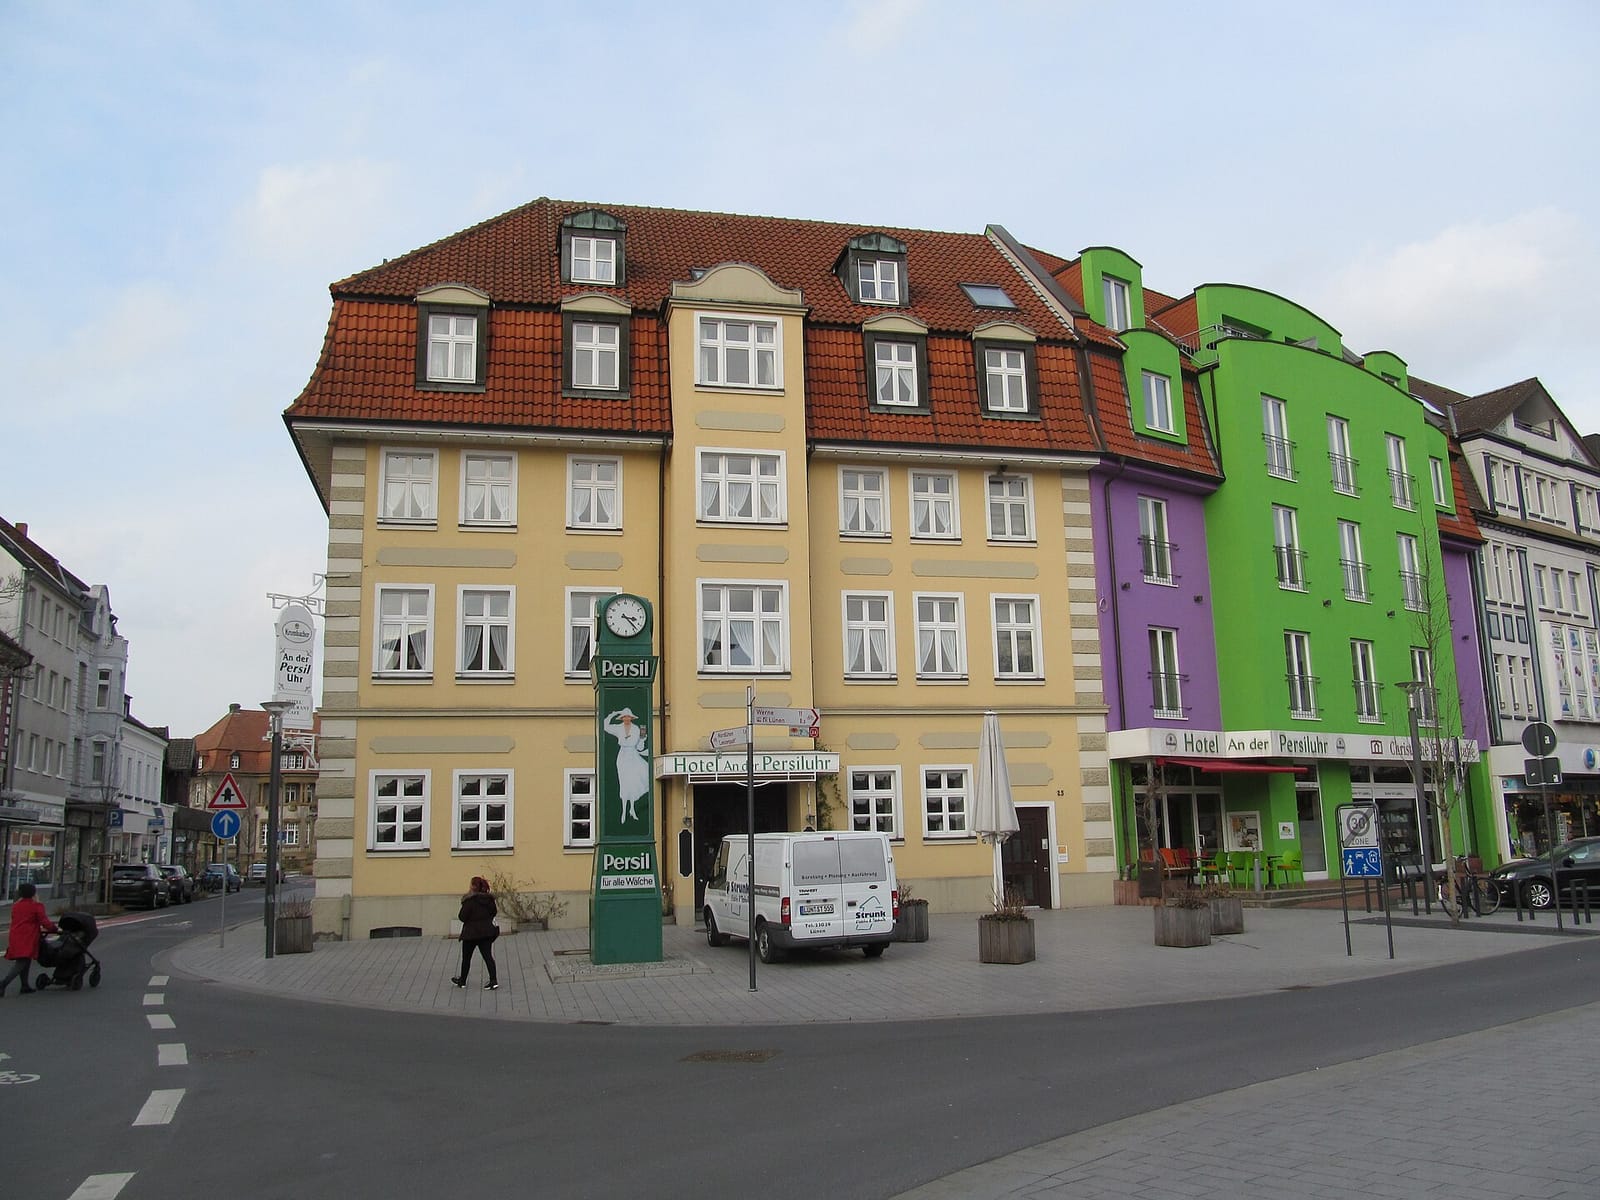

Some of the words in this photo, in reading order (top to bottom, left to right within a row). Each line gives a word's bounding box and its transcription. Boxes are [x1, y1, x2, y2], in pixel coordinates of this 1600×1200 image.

[282, 653, 294, 661] An
[295, 654, 309, 663] der
[280, 661, 312, 675] Persil
[602, 659, 649, 677] Persil
[287, 673, 303, 683] Uhr
[1184, 733, 1219, 753] Hotel
[1228, 738, 1245, 751] An
[1249, 737, 1269, 751] der
[1279, 734, 1328, 754] Persiluhr
[674, 757, 719, 773] Hotel
[723, 760, 739, 771] An
[762, 755, 831, 771] Persiluhr
[110, 811, 119, 826] P
[1351, 817, 1367, 830] 30
[603, 852, 650, 870] Persil
[602, 877, 612, 887] für
[612, 877, 625, 886] alle
[855, 910, 886, 919] Strunk
